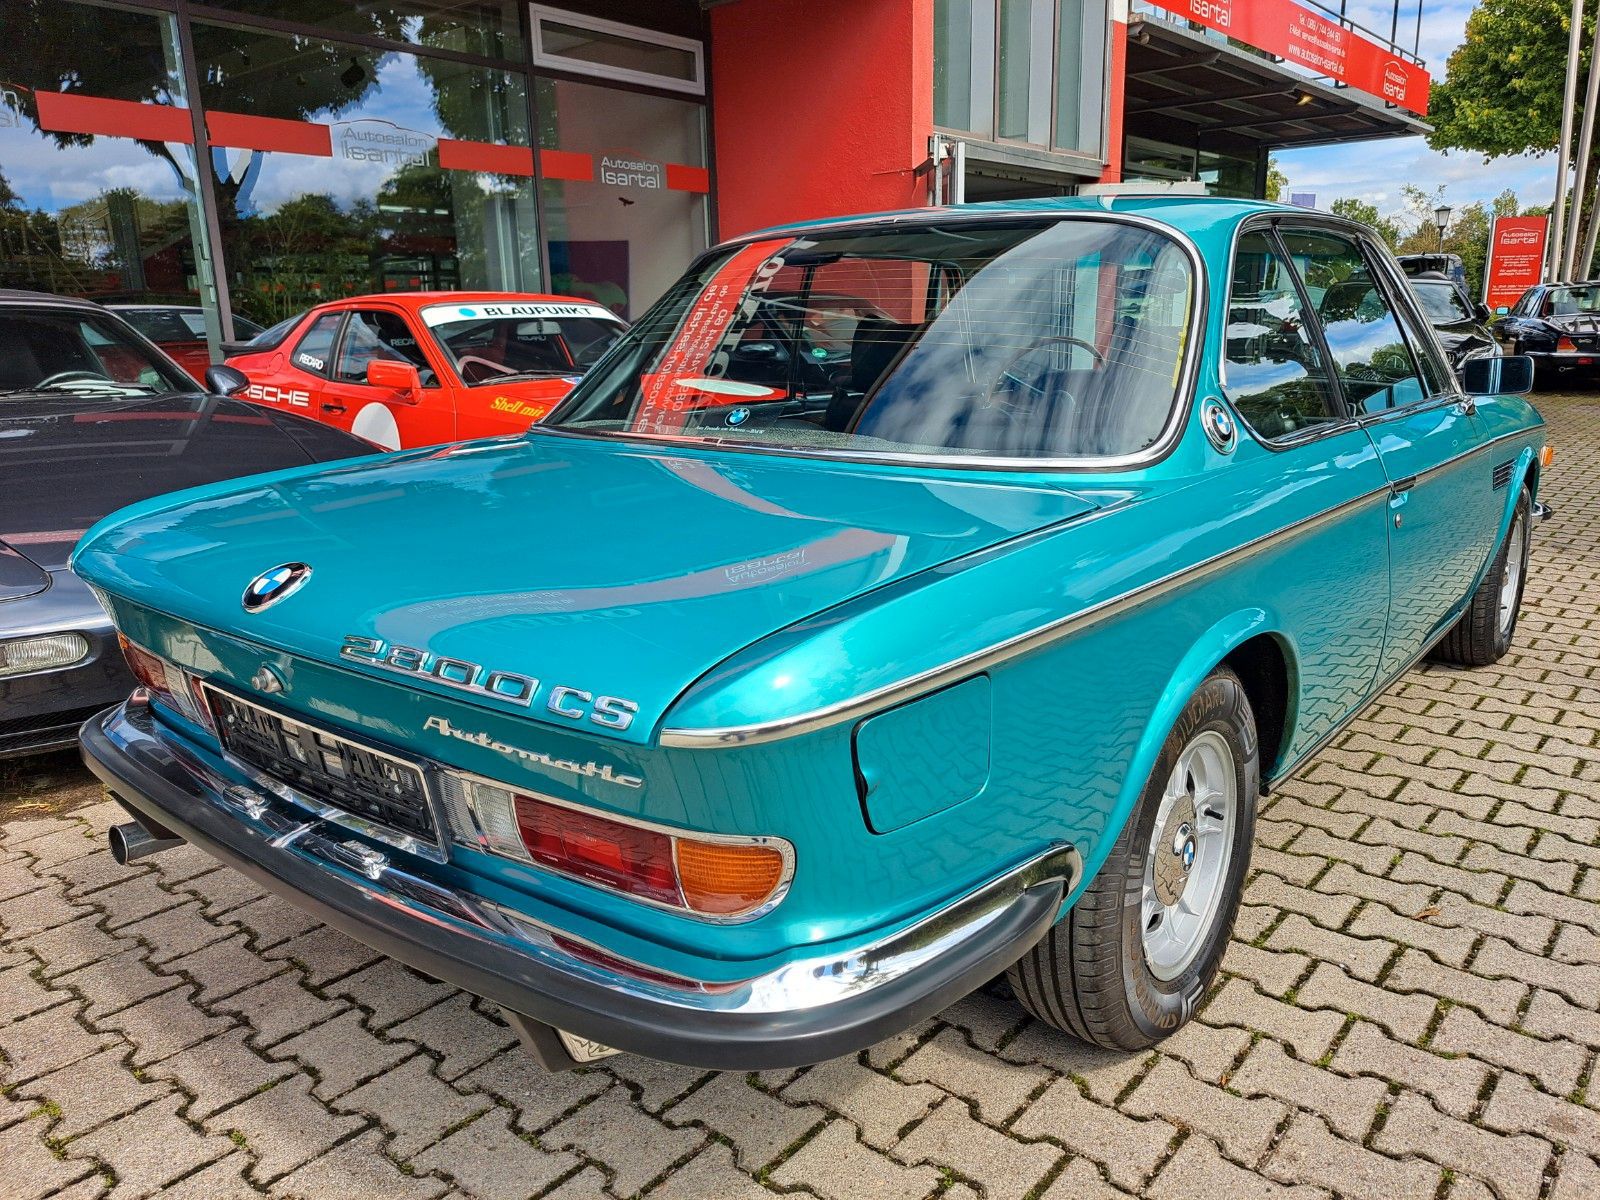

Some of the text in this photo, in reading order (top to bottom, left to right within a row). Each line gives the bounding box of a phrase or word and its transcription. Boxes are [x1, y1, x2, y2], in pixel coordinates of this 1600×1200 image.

[1288, 43, 1345, 76] www.autosalon-isartal.de
[1385, 68, 1407, 86] Autosalon
[1383, 77, 1406, 101] Isartal
[343, 127, 429, 148] Autosalon
[341, 144, 430, 168] Isartal
[601, 156, 660, 172] Autosalon
[601, 167, 660, 189] Isartal
[1500, 235, 1538, 245] Isartal
[483, 306, 592, 316] BLAUPUNKT
[298, 352, 324, 371] RECARO
[490, 396, 524, 413] Shell
[339, 635, 639, 730] 2800 CS
[422, 715, 644, 788] Automatic
